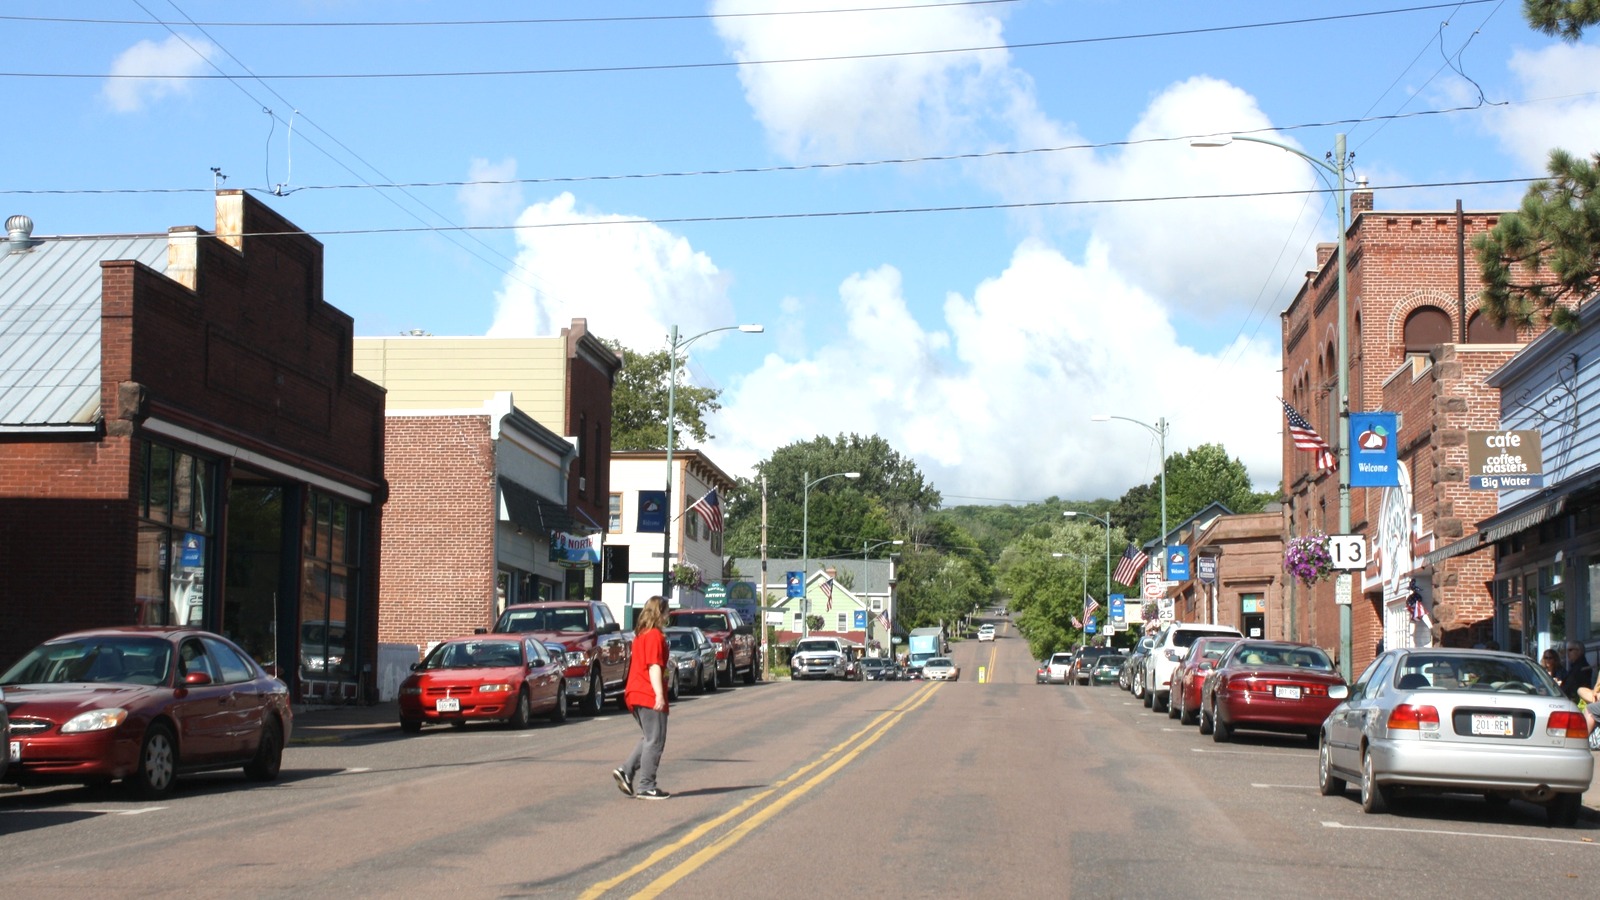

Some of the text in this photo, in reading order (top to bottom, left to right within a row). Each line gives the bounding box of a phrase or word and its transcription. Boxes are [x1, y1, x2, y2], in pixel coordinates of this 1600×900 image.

[1486, 431, 1521, 448] cafe
[1486, 453, 1522, 465] coffee
[1358, 462, 1389, 473] Welcome
[1482, 463, 1528, 473] roasters
[1481, 476, 1531, 489] Big Water
[568, 536, 594, 550] NORTH
[1335, 542, 1362, 562] 13
[1160, 610, 1173, 619] 25
